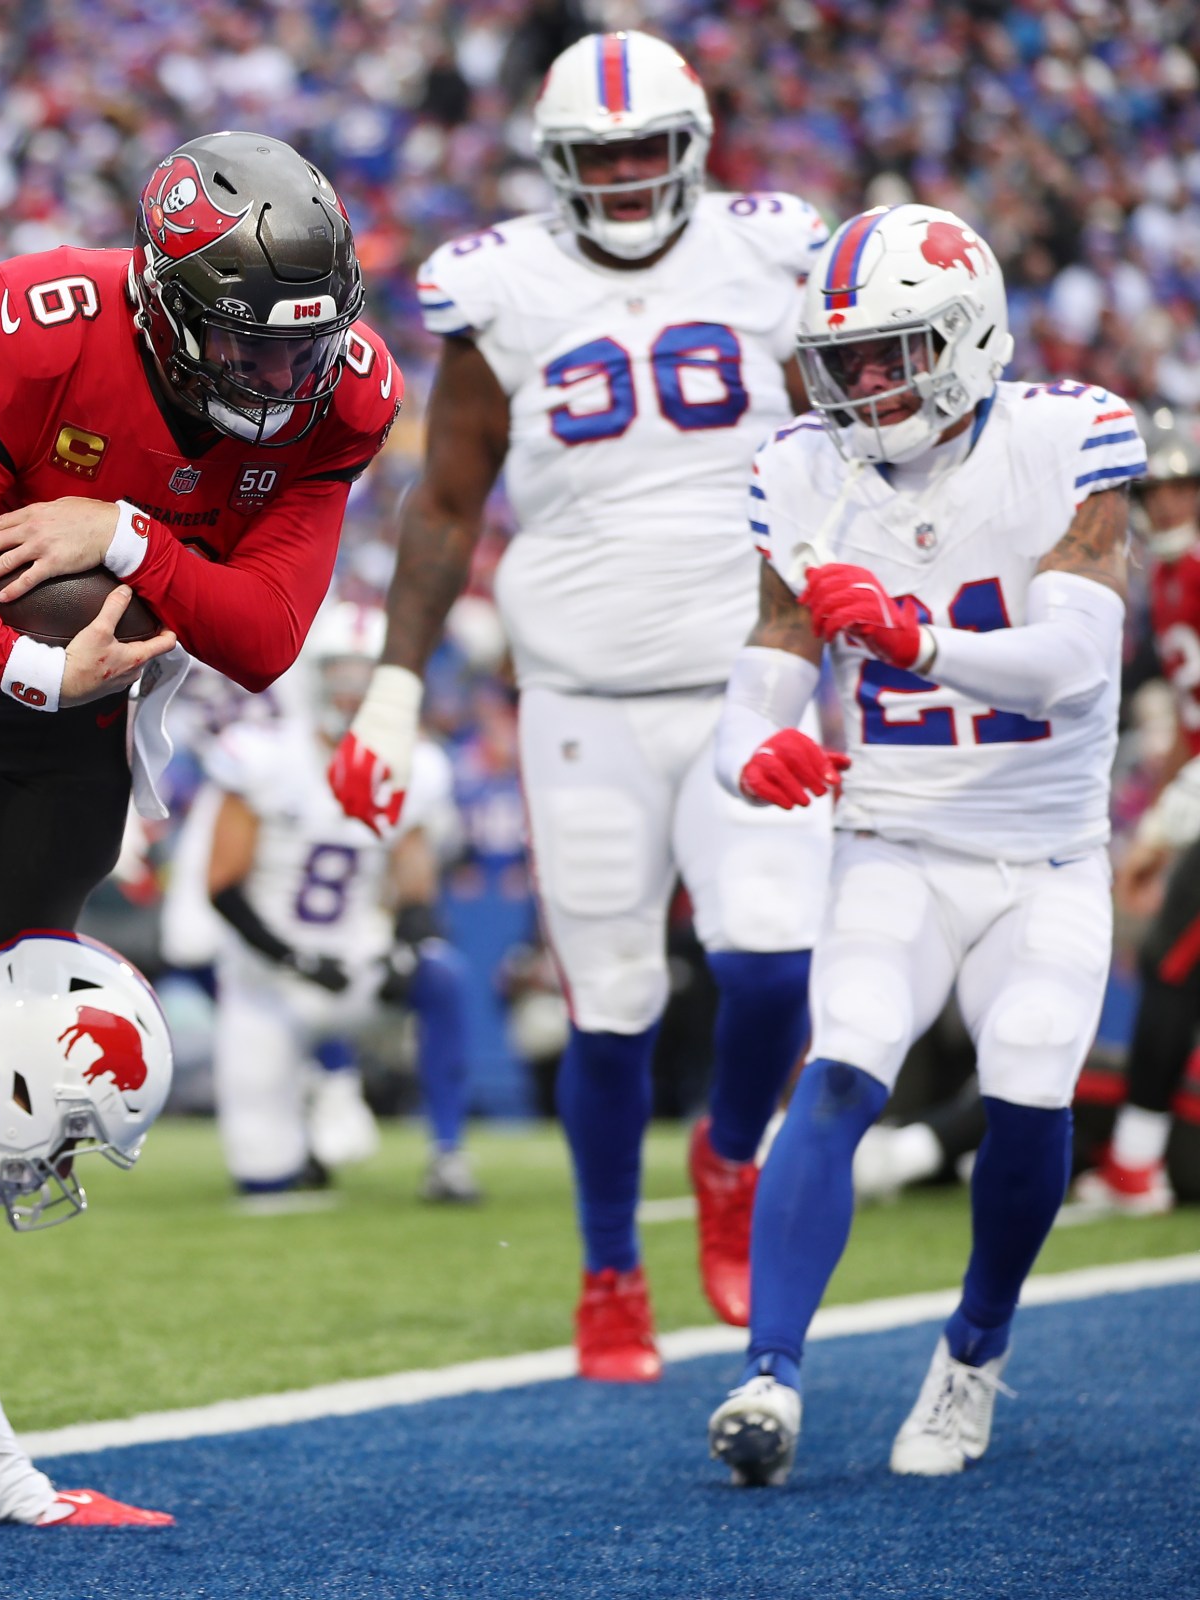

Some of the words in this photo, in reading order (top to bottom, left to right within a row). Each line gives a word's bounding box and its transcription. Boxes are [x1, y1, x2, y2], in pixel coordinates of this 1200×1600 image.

[25, 274, 102, 329] 6
[215, 303, 251, 319] OAKLEY
[293, 301, 322, 320] BUCS
[56, 426, 105, 467] C
[239, 469, 277, 492] 50
[123, 495, 220, 526] CCANEERS
[846, 576, 1051, 746] 21
[295, 843, 359, 926] 8
